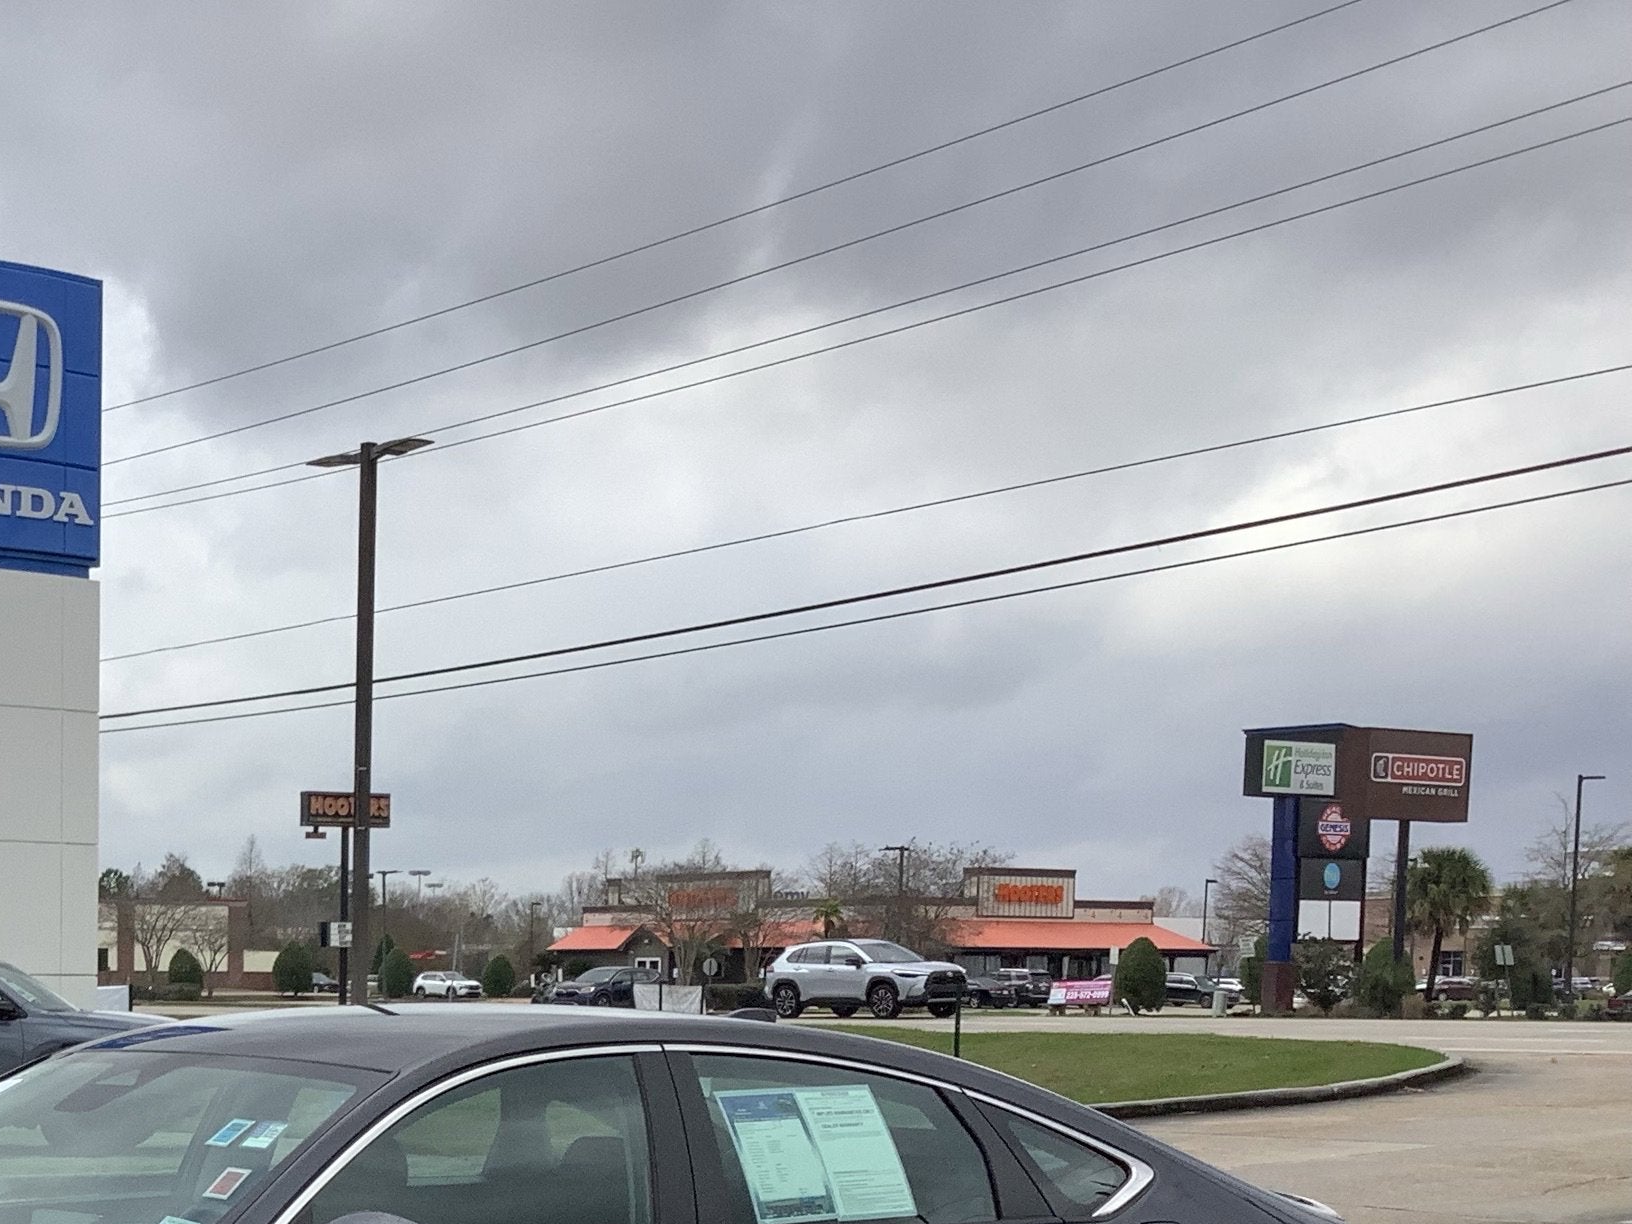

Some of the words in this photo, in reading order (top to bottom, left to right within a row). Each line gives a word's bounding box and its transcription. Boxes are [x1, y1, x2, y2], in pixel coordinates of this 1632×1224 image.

[1294, 760, 1332, 778] Express
[1393, 761, 1461, 779] CHIPOTLE
[1402, 786, 1436, 795] MEXICAN
[1437, 788, 1458, 797] GRILL
[310, 795, 388, 816] HOORS
[1320, 823, 1349, 833] GENESIS
